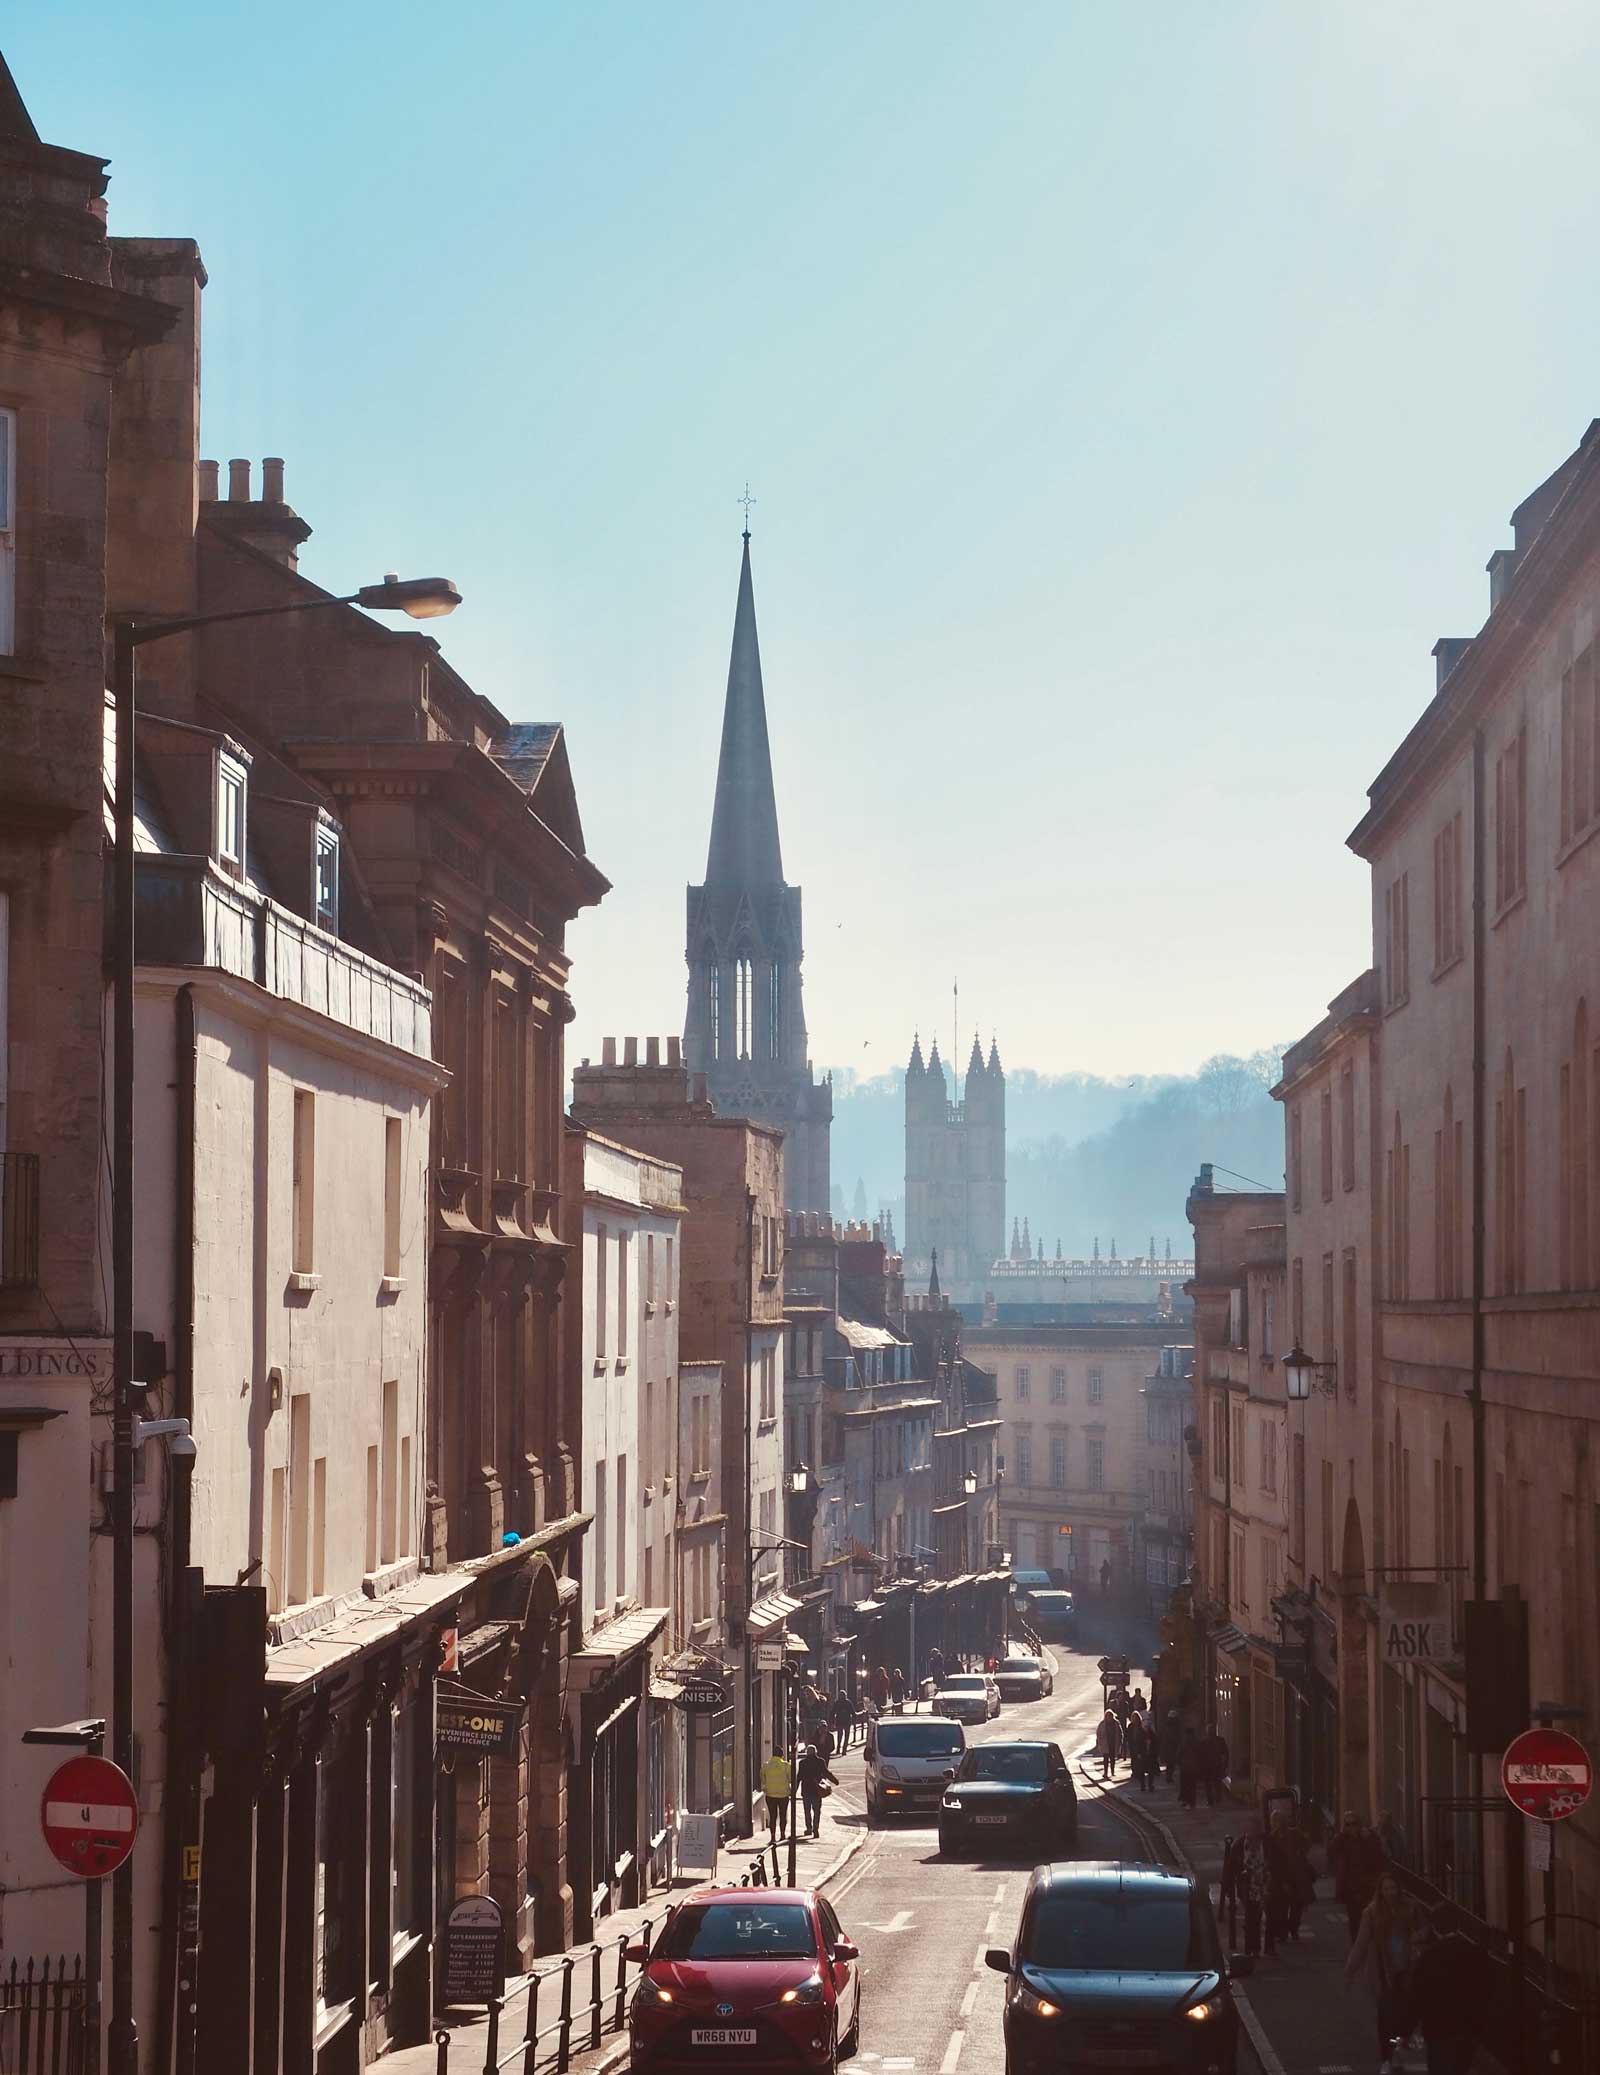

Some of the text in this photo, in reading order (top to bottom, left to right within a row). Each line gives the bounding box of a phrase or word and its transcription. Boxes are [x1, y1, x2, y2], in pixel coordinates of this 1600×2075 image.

[1387, 1624, 1431, 1656] ASK
[676, 1692, 722, 1703] UNISEX
[435, 1728, 479, 1739] ONVENIENCE
[696, 2031, 751, 2042] WR68 NYU
